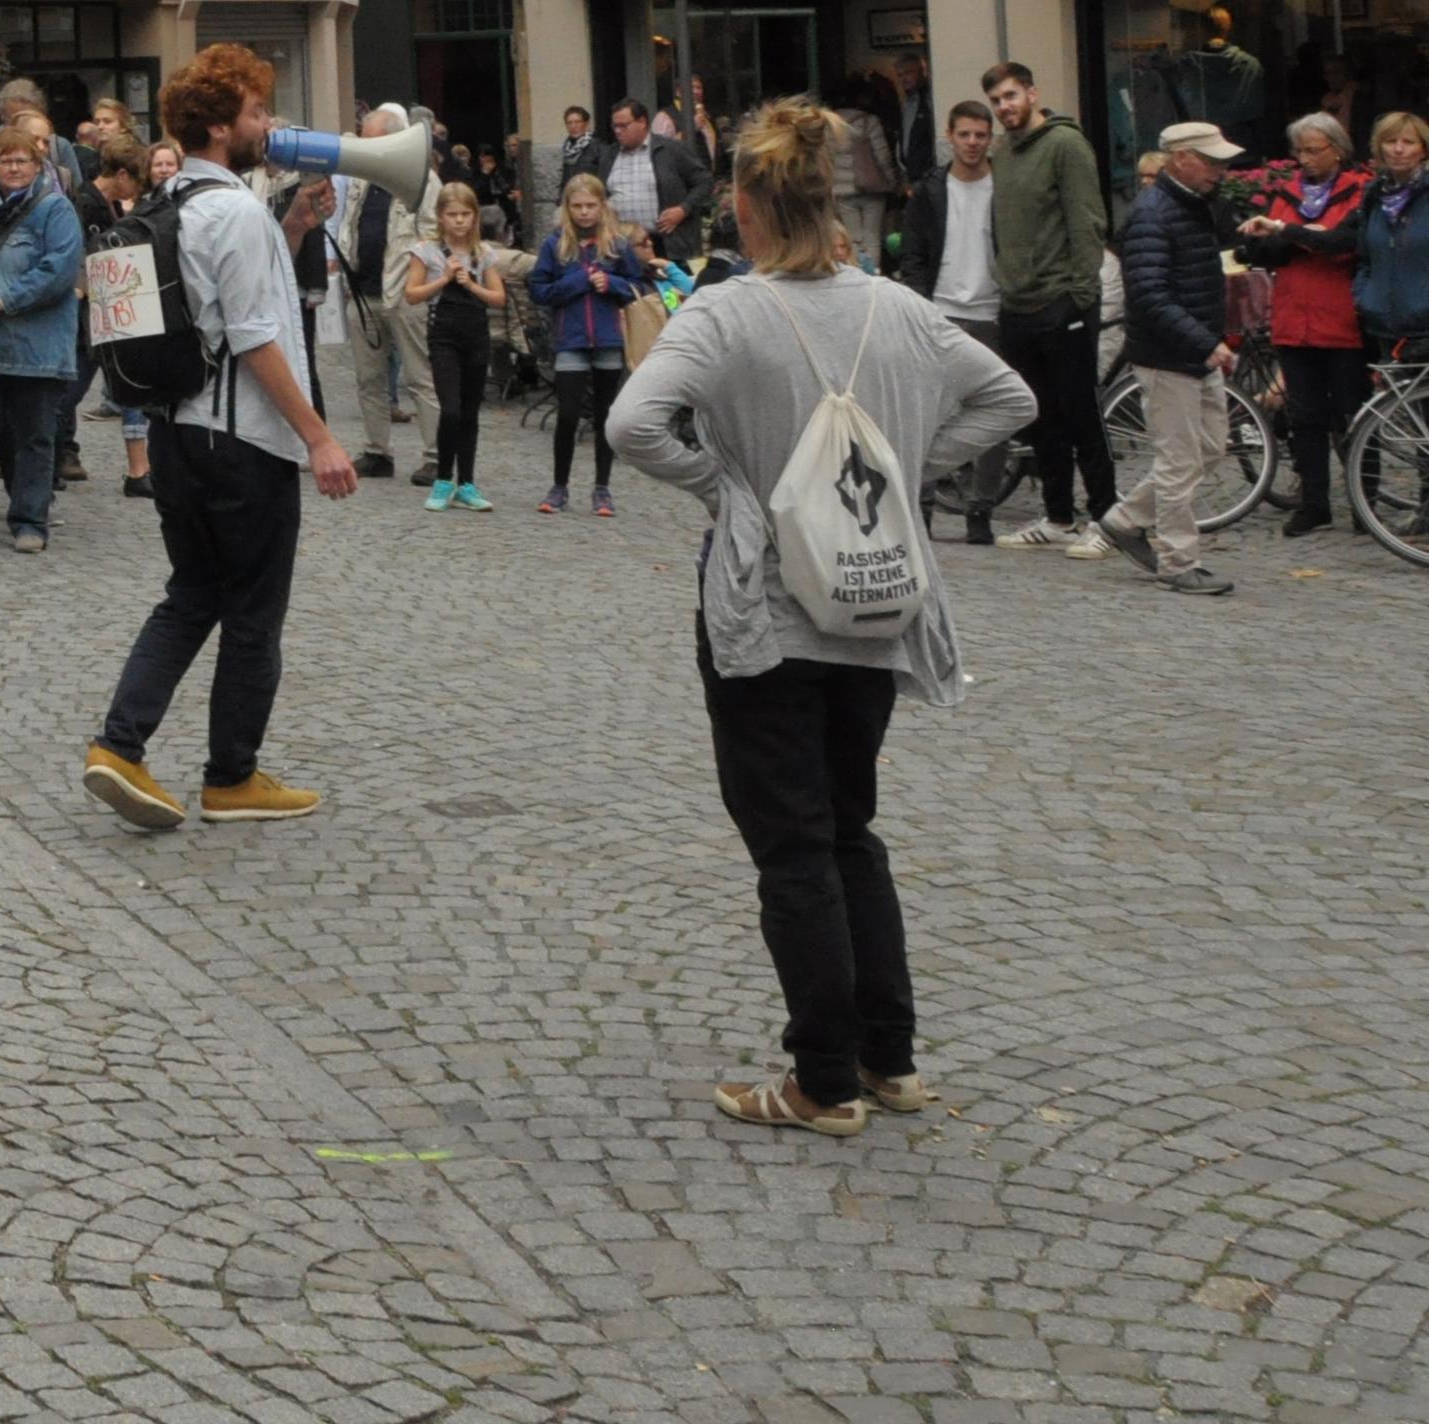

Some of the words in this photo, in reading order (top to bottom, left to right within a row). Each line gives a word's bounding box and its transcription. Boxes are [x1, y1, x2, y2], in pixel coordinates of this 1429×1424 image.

[844, 571, 865, 586] IST
[868, 564, 907, 585] KEINE
[830, 577, 919, 604] ALTERNATIVE
